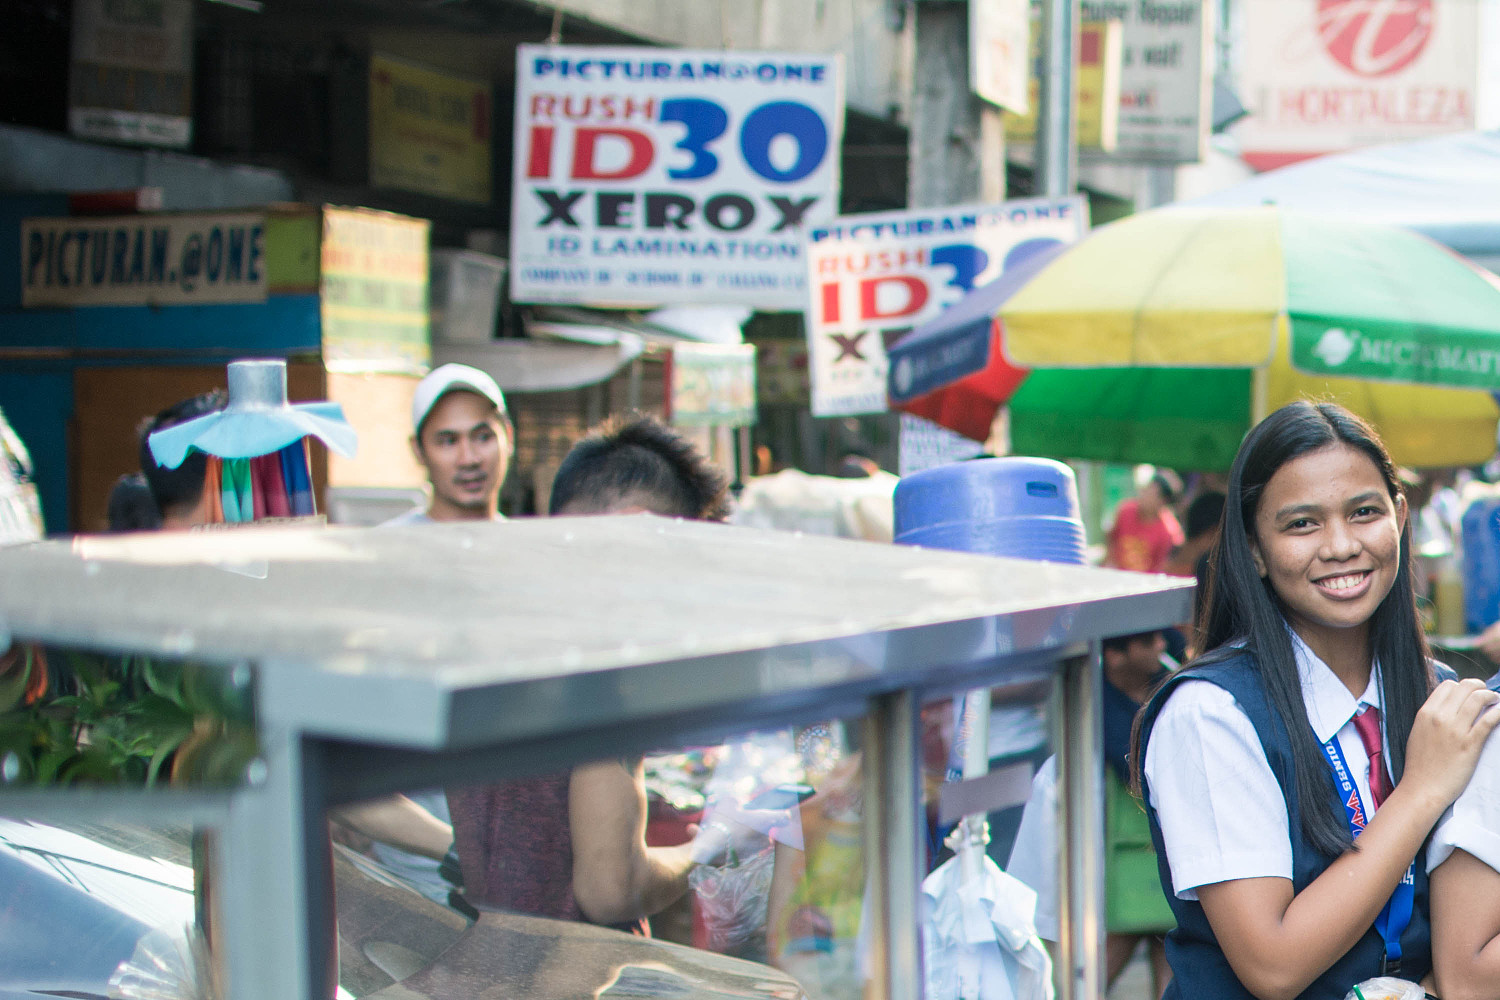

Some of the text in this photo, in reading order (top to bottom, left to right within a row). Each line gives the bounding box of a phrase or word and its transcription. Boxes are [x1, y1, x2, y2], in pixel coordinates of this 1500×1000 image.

[530, 94, 654, 120] RUSH
[526, 96, 828, 184] ID 30
[532, 189, 820, 233] XEROX
[548, 237, 799, 259] ID LAMINATION
[818, 249, 927, 275] RUSH
[821, 275, 930, 325] ID
[1346, 788, 1369, 830] AMA
